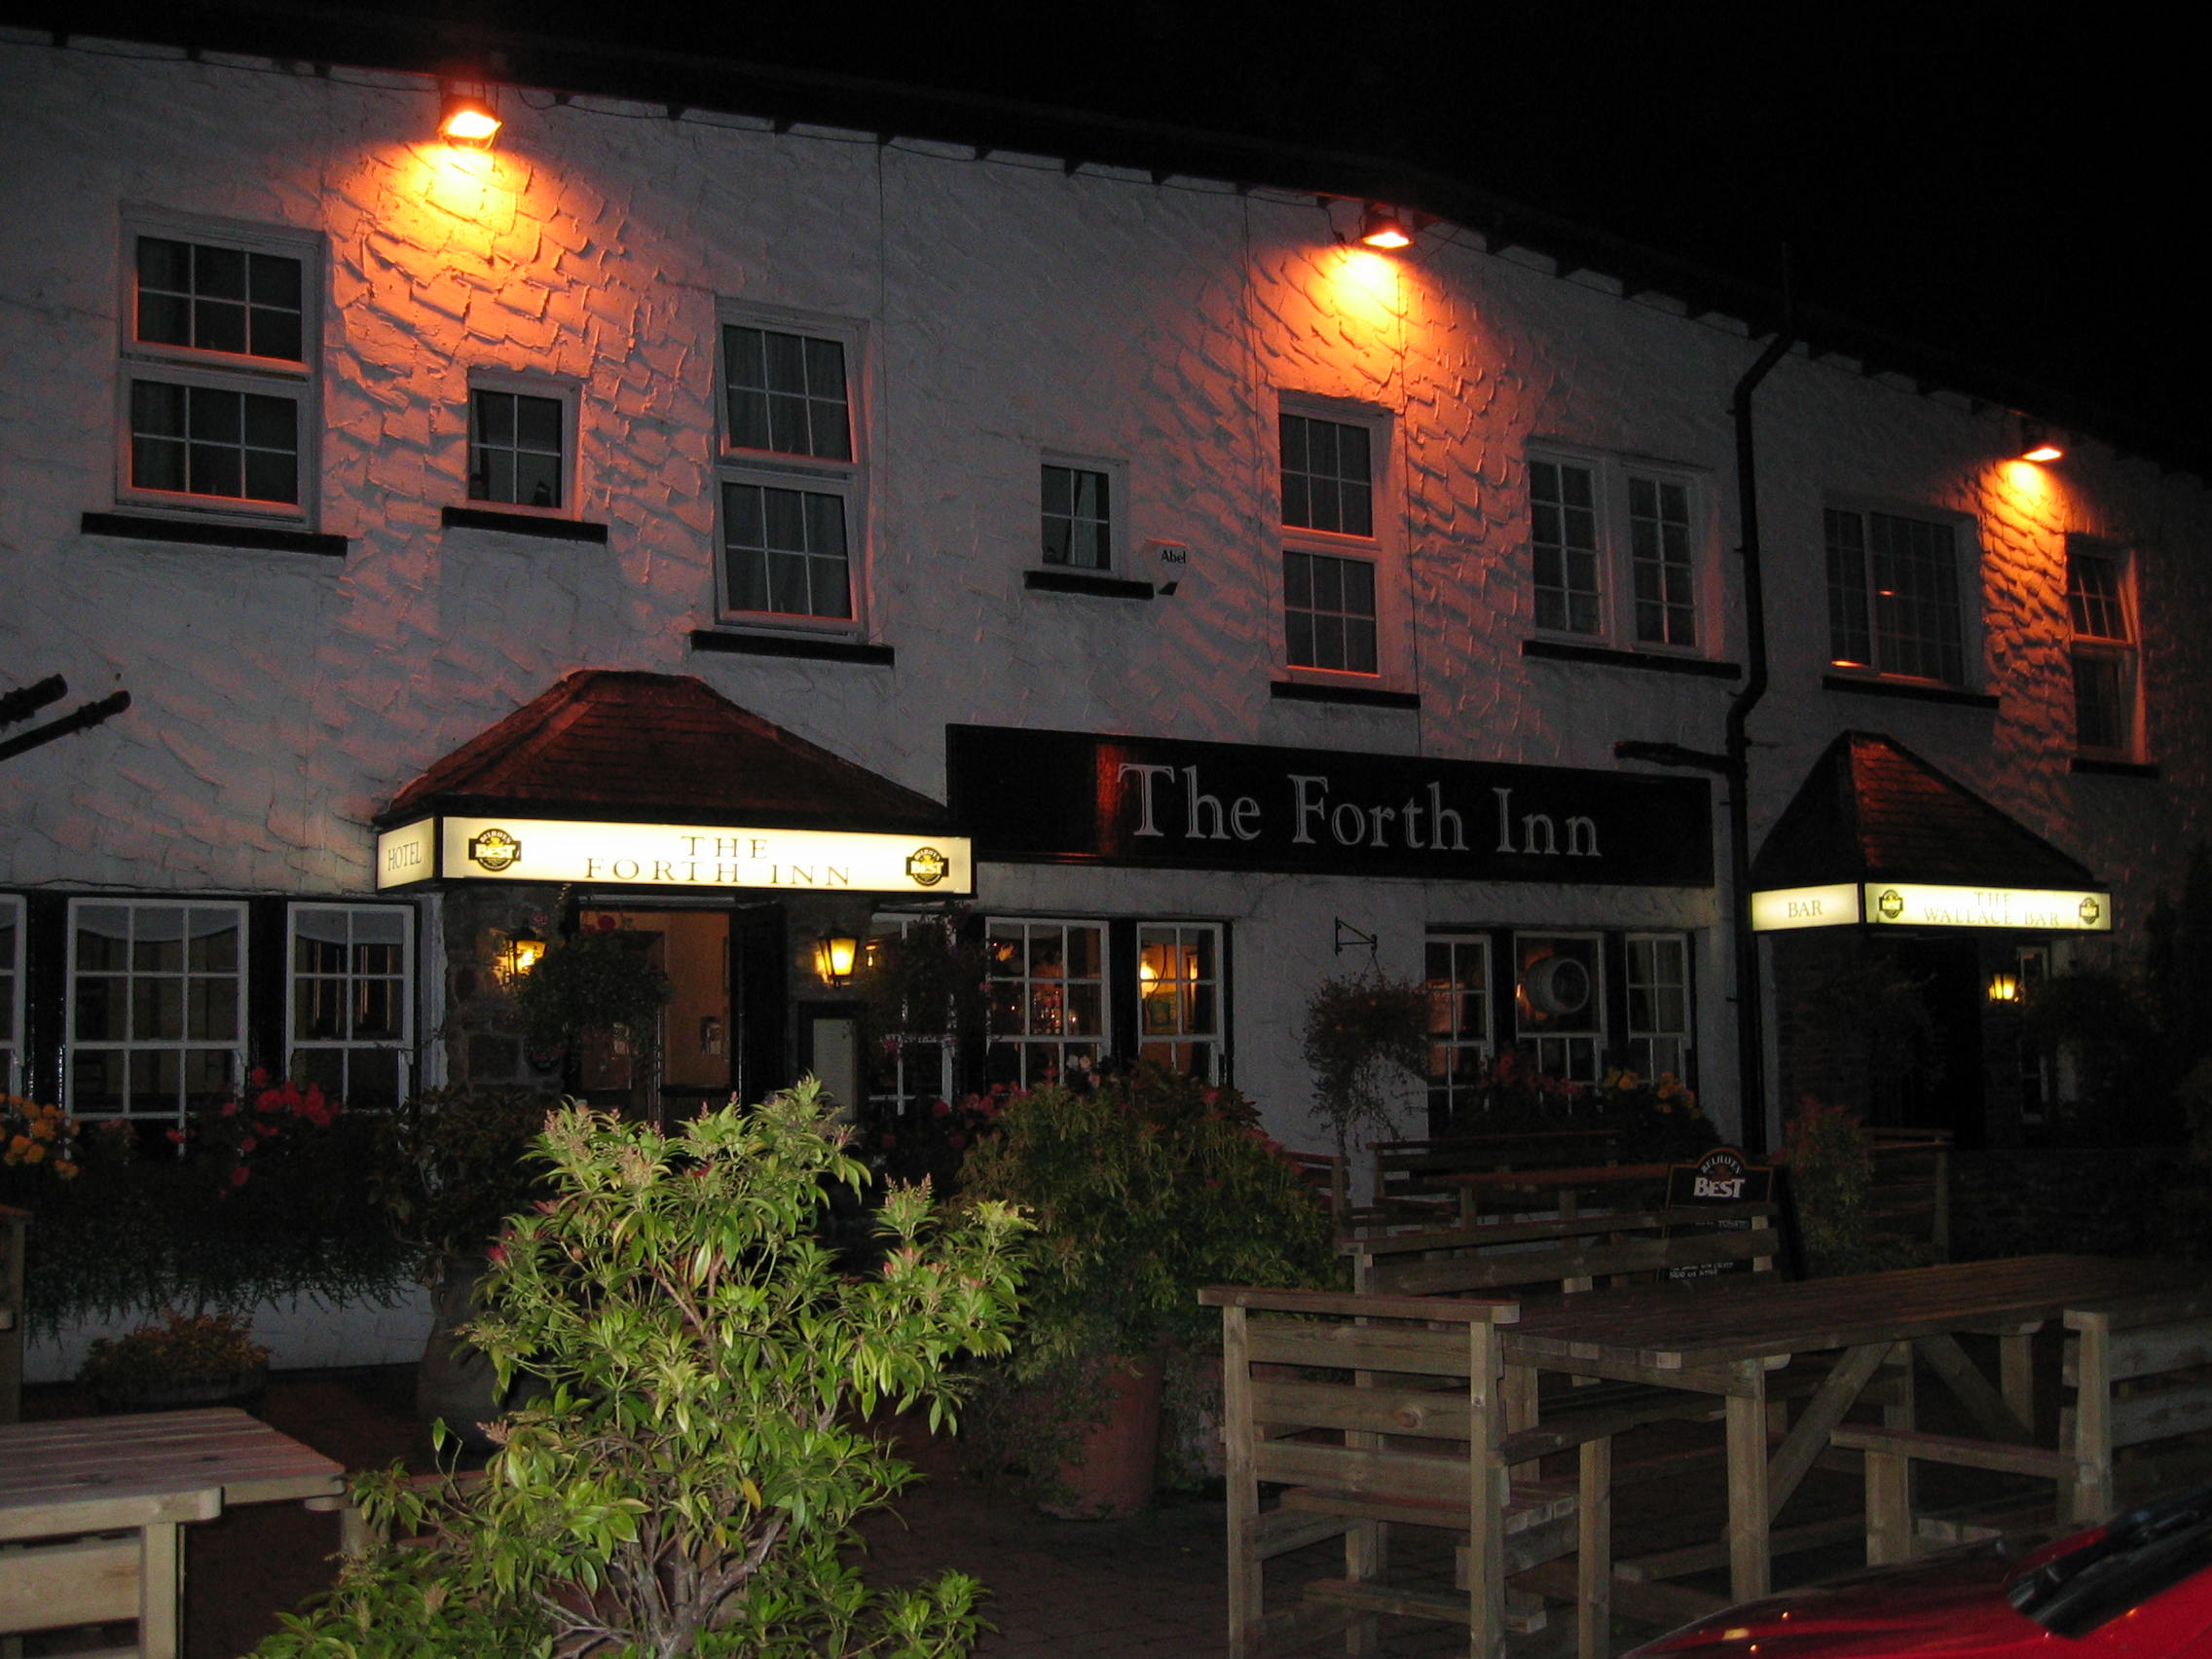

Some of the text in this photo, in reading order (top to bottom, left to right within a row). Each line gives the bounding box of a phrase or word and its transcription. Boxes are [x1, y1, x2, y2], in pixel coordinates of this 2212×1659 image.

[1117, 762, 1603, 858] The Forth Inn
[387, 840, 423, 872] HOTEL
[475, 843, 517, 859] BEST
[681, 835, 768, 860] THE
[584, 857, 850, 887] FORTH INN
[1788, 899, 1825, 919] BAR
[1972, 891, 2011, 906] THE
[1923, 906, 2060, 928] WALLACE BAR
[1694, 1177, 1746, 1198] BEST
